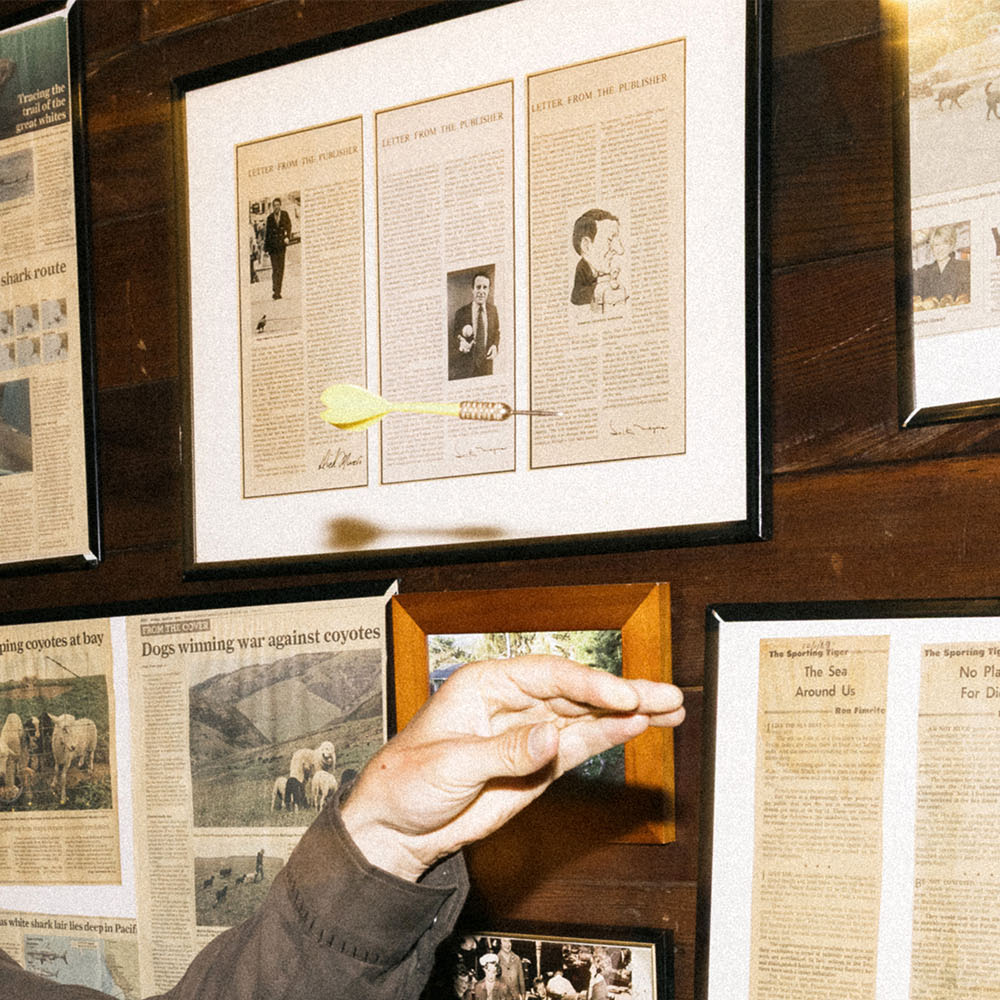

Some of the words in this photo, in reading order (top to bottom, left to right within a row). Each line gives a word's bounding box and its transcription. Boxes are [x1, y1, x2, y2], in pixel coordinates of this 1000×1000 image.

[17, 88, 51, 105] Tracing
[52, 83, 67, 96] the
[531, 99, 564, 113] LETTER
[567, 91, 593, 106] FROM
[597, 85, 615, 98] THE
[619, 73, 668, 93] PUBLISHER
[22, 102, 41, 117] trail
[41, 99, 52, 112] of
[52, 96, 67, 109] the
[15, 120, 38, 135] great
[39, 110, 67, 128] whites
[382, 133, 410, 148] LETTER
[414, 127, 437, 141] FROM
[441, 122, 457, 135] THE
[460, 111, 504, 130] PUBLISHER
[248, 164, 274, 178] LETTER
[277, 158, 299, 172] FROM
[302, 155, 316, 166] THE
[318, 145, 358, 162] PUBLISHER
[0, 267, 32, 288] shark
[34, 260, 67, 279] route
[142, 624, 164, 635] FROM
[165, 623, 181, 634] THE
[182, 621, 209, 633] COVER
[25, 635, 68, 652] coyotes
[69, 635, 81, 646] at
[83, 631, 105, 648] bay
[142, 641, 176, 659] Dogs
[178, 637, 235, 655] winning
[238, 636, 265, 650] war
[268, 629, 321, 650] against
[324, 624, 381, 645] coyotes
[769, 650, 784, 658] The
[787, 649, 823, 660] Sporting
[826, 648, 849, 658] Tiger
[924, 649, 940, 658] The
[944, 648, 985, 659] Sporting
[804, 665, 823, 677] The
[828, 665, 848, 677] Sea
[960, 665, 978, 678] No
[795, 685, 836, 697] Around
[841, 684, 856, 697] Us
[961, 687, 980, 699] For
[986, 686, 1000, 699] Di
[9, 917, 30, 929] white
[31, 918, 53, 930] shark
[54, 919, 68, 931] lair
[69, 920, 83, 932] lies
[84, 921, 104, 935] deep
[104, 921, 113, 933] in
